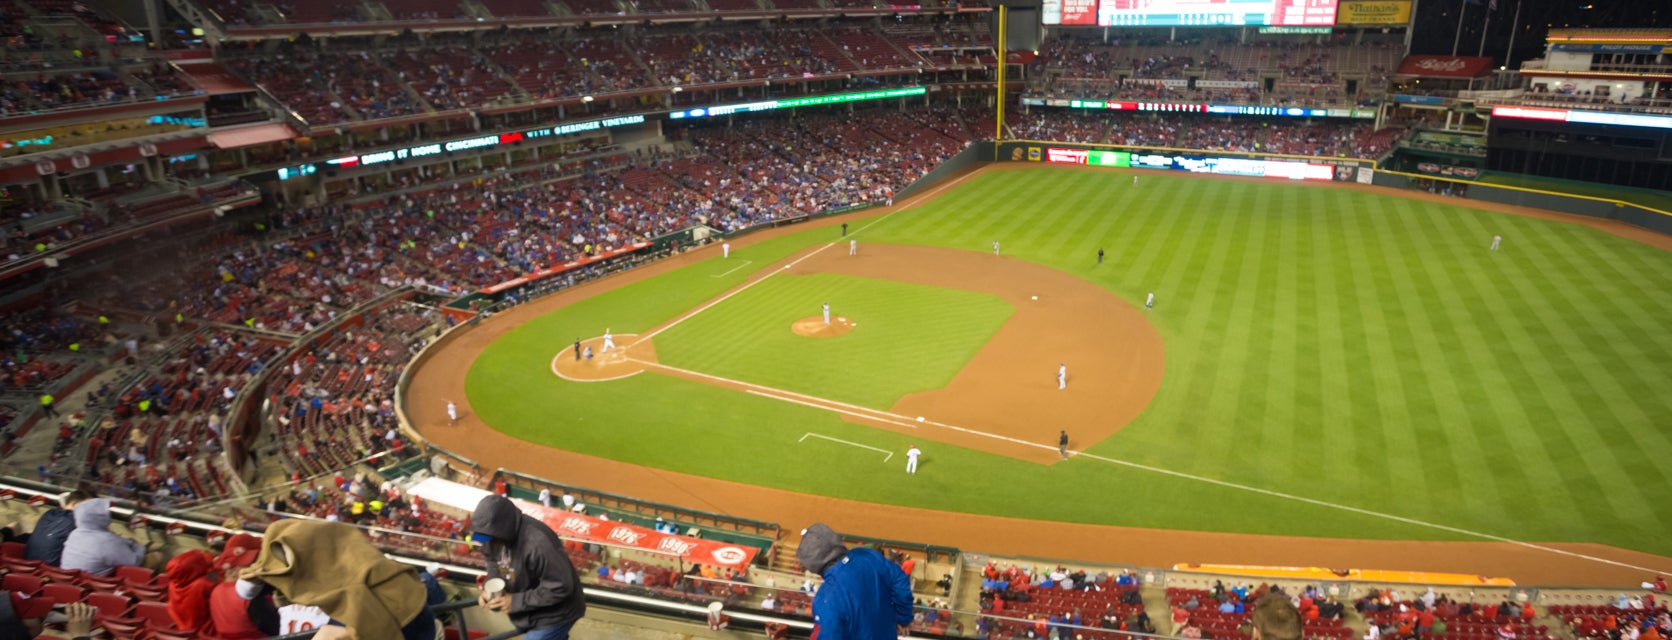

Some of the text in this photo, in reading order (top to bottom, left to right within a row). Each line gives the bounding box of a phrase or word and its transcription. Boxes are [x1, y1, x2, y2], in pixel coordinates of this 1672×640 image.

[1415, 58, 1466, 71] Reds
[602, 115, 644, 127] VINEYARDS
[361, 136, 499, 165] BRING IT HOME CINCINNATI
[565, 517, 591, 534] 1975
[611, 528, 638, 544] 1976
[661, 537, 688, 554] 1990
